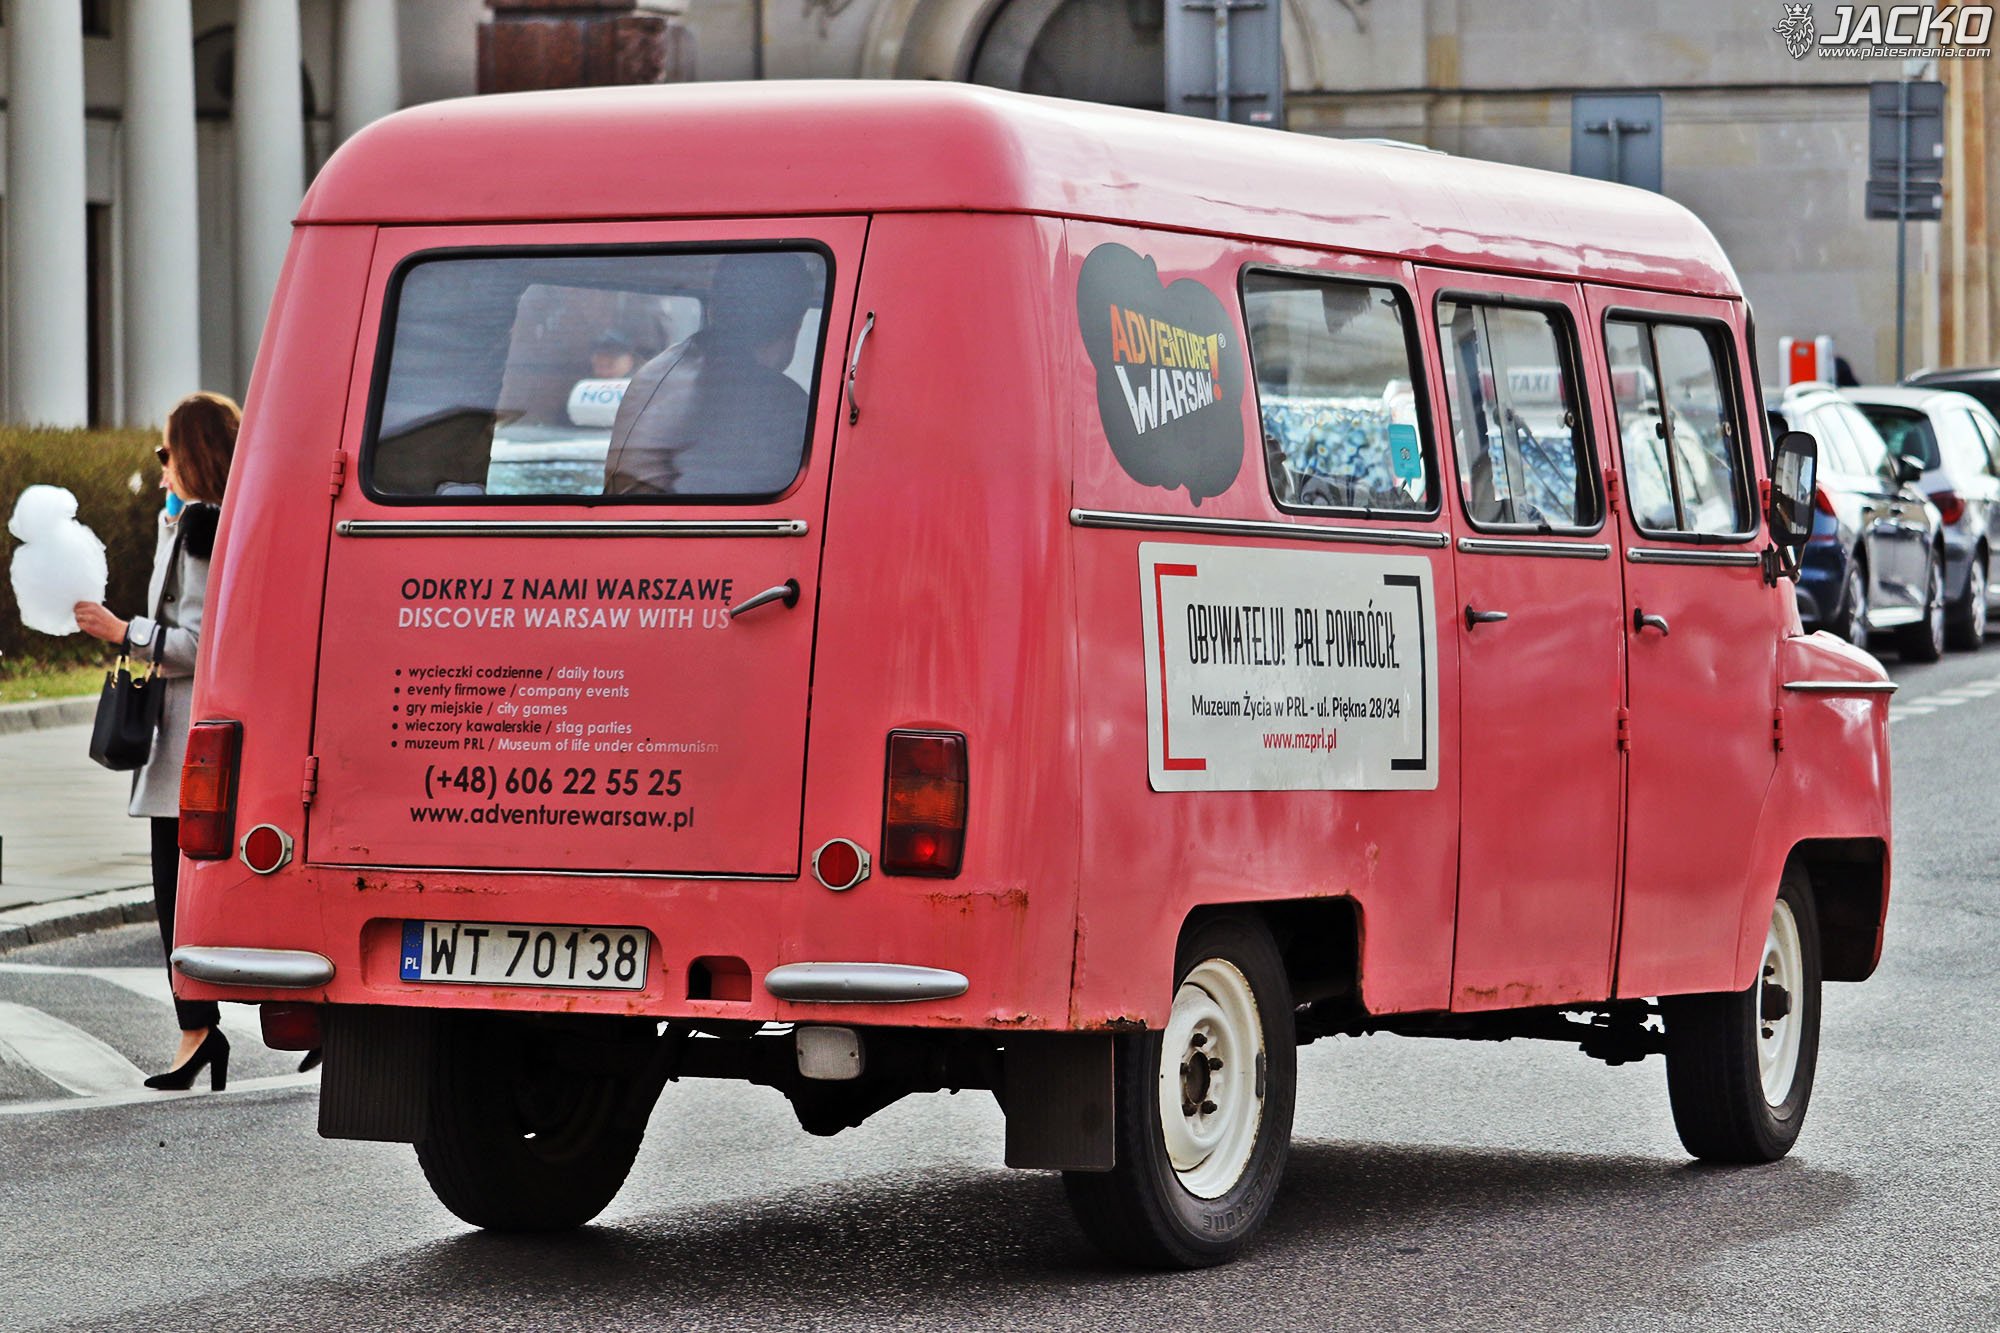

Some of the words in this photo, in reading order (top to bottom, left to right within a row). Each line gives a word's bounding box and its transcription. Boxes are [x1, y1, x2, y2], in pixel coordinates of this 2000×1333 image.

[1510, 374, 1550, 393] TAXI
[580, 390, 622, 404] NO
[1114, 365, 1213, 435] WARSAW
[401, 578, 493, 600] ODKRYJ
[502, 578, 515, 600] Z
[522, 578, 587, 600] NAMI
[596, 578, 734, 606] WARSZAWĘ
[399, 607, 516, 629] DISCOVER
[524, 607, 631, 629] WARSAW
[639, 608, 694, 629] WITH
[702, 608, 730, 629] US
[1187, 603, 1286, 666] OBYWATELU!
[1294, 607, 1324, 666] PRL
[1326, 599, 1400, 669] POWRÓCIŁ
[408, 666, 473, 680] wycieczki
[476, 666, 543, 679] codzienne
[546, 666, 553, 681] /
[557, 666, 590, 681] daily
[593, 667, 625, 680] tours
[407, 684, 452, 698] eventy
[454, 683, 506, 697] firmowe
[518, 686, 582, 700] company
[586, 685, 630, 698] events
[406, 704, 426, 717] gry
[430, 702, 483, 717] miejskie
[487, 702, 494, 716] /
[497, 702, 518, 717] city
[522, 705, 568, 718] games
[1191, 694, 1241, 717] Muzeum
[1243, 690, 1272, 721] Życia
[1274, 702, 1284, 717] w
[1286, 696, 1308, 717] PRL
[1317, 697, 1329, 718] ul.
[1332, 696, 1367, 722] Piękna
[1369, 697, 1400, 719] 28/34
[405, 719, 462, 735] wieczory
[466, 719, 542, 733] kawalerskie
[545, 721, 552, 735] /
[555, 721, 584, 737] stag
[587, 721, 632, 737] parties
[404, 738, 460, 750] muzeum
[464, 737, 485, 750] PRL
[488, 737, 495, 752] /
[498, 738, 551, 751] Museum
[556, 739, 568, 752] of
[571, 738, 590, 752] life
[594, 739, 633, 752] under
[637, 740, 719, 753] communism
[1263, 728, 1337, 753] www.mzprl.pl
[424, 765, 497, 800] (+48)
[505, 767, 553, 795] 606
[562, 767, 596, 795] 22
[605, 769, 639, 796] 55
[647, 769, 682, 797] 25
[410, 804, 695, 832] www.adventurewarsaw.pl
[404, 957, 420, 971] PL
[430, 927, 490, 976] WT
[505, 930, 638, 982] 70138
